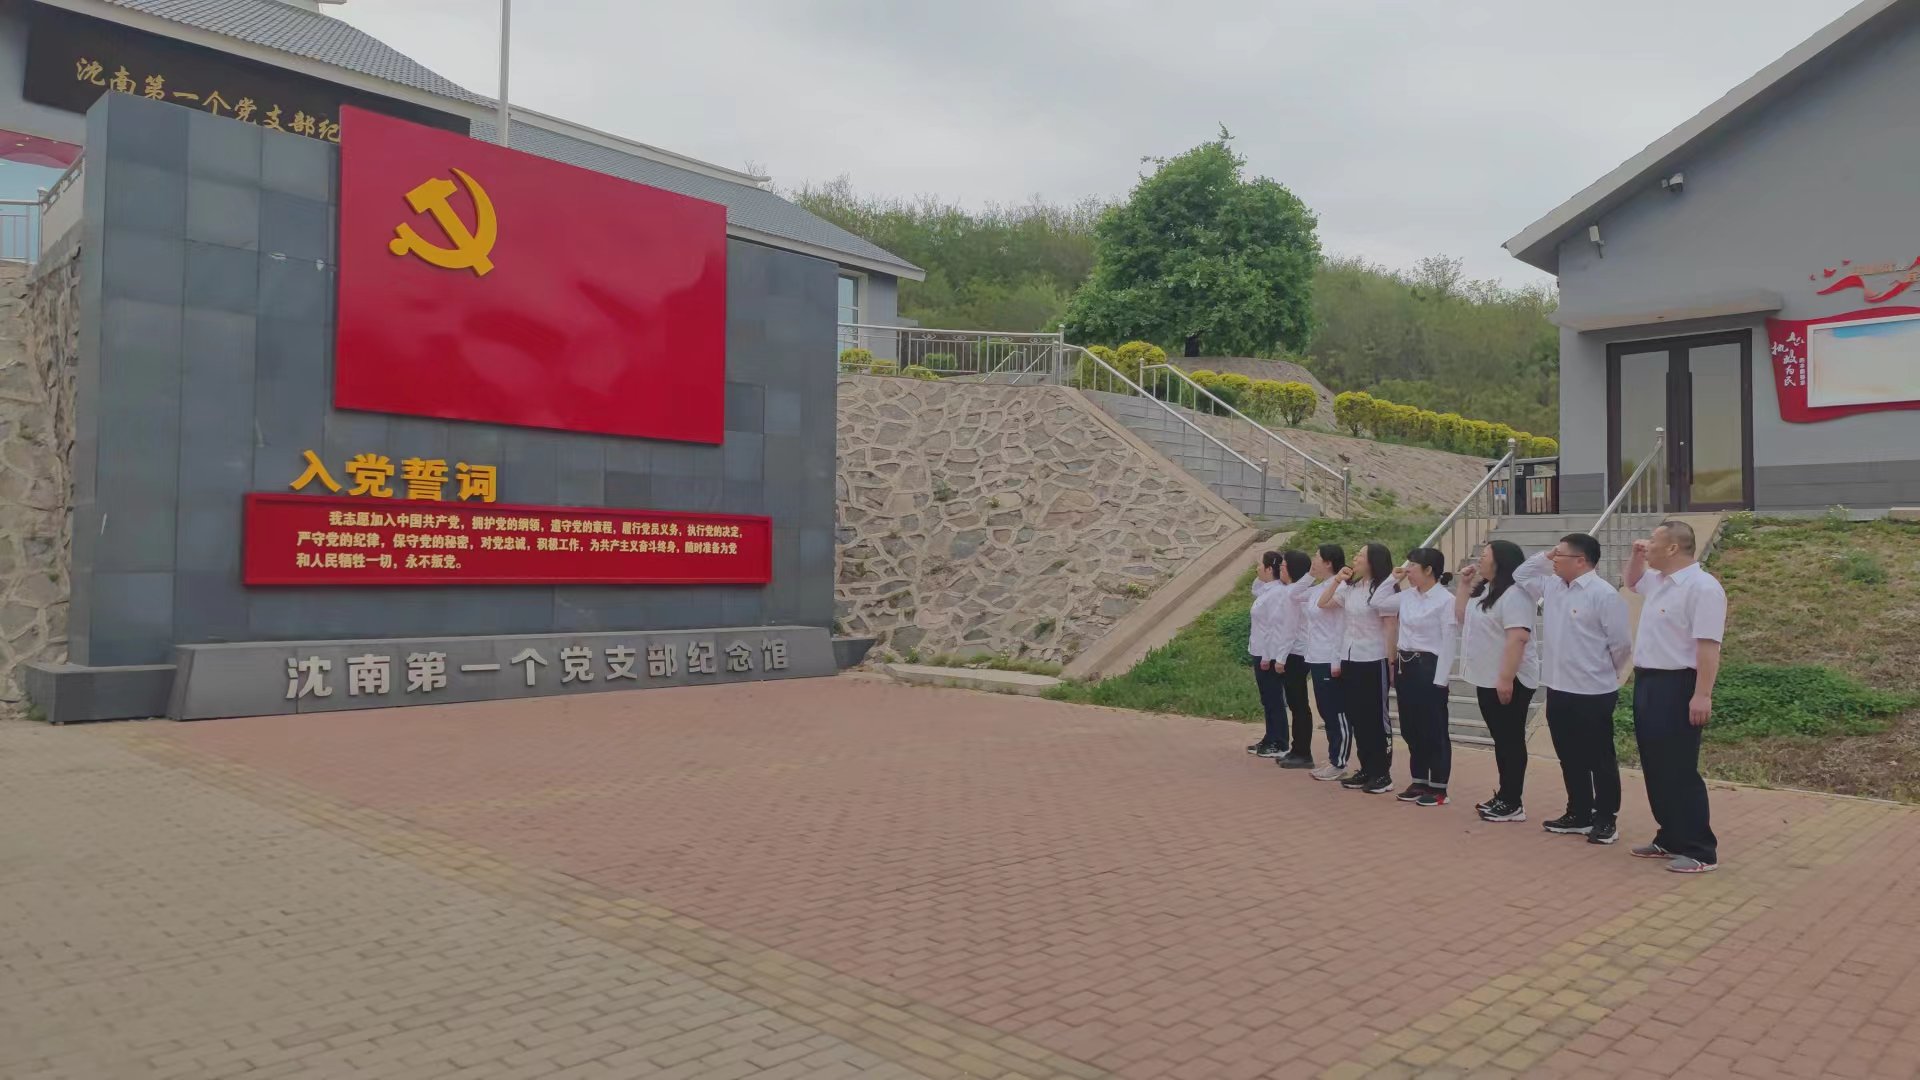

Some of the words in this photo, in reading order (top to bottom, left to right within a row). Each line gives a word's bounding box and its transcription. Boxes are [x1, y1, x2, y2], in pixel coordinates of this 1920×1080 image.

[290, 450, 496, 503] 入党誓词
[285, 638, 789, 699] 沈南第一个党支部纪念馆
